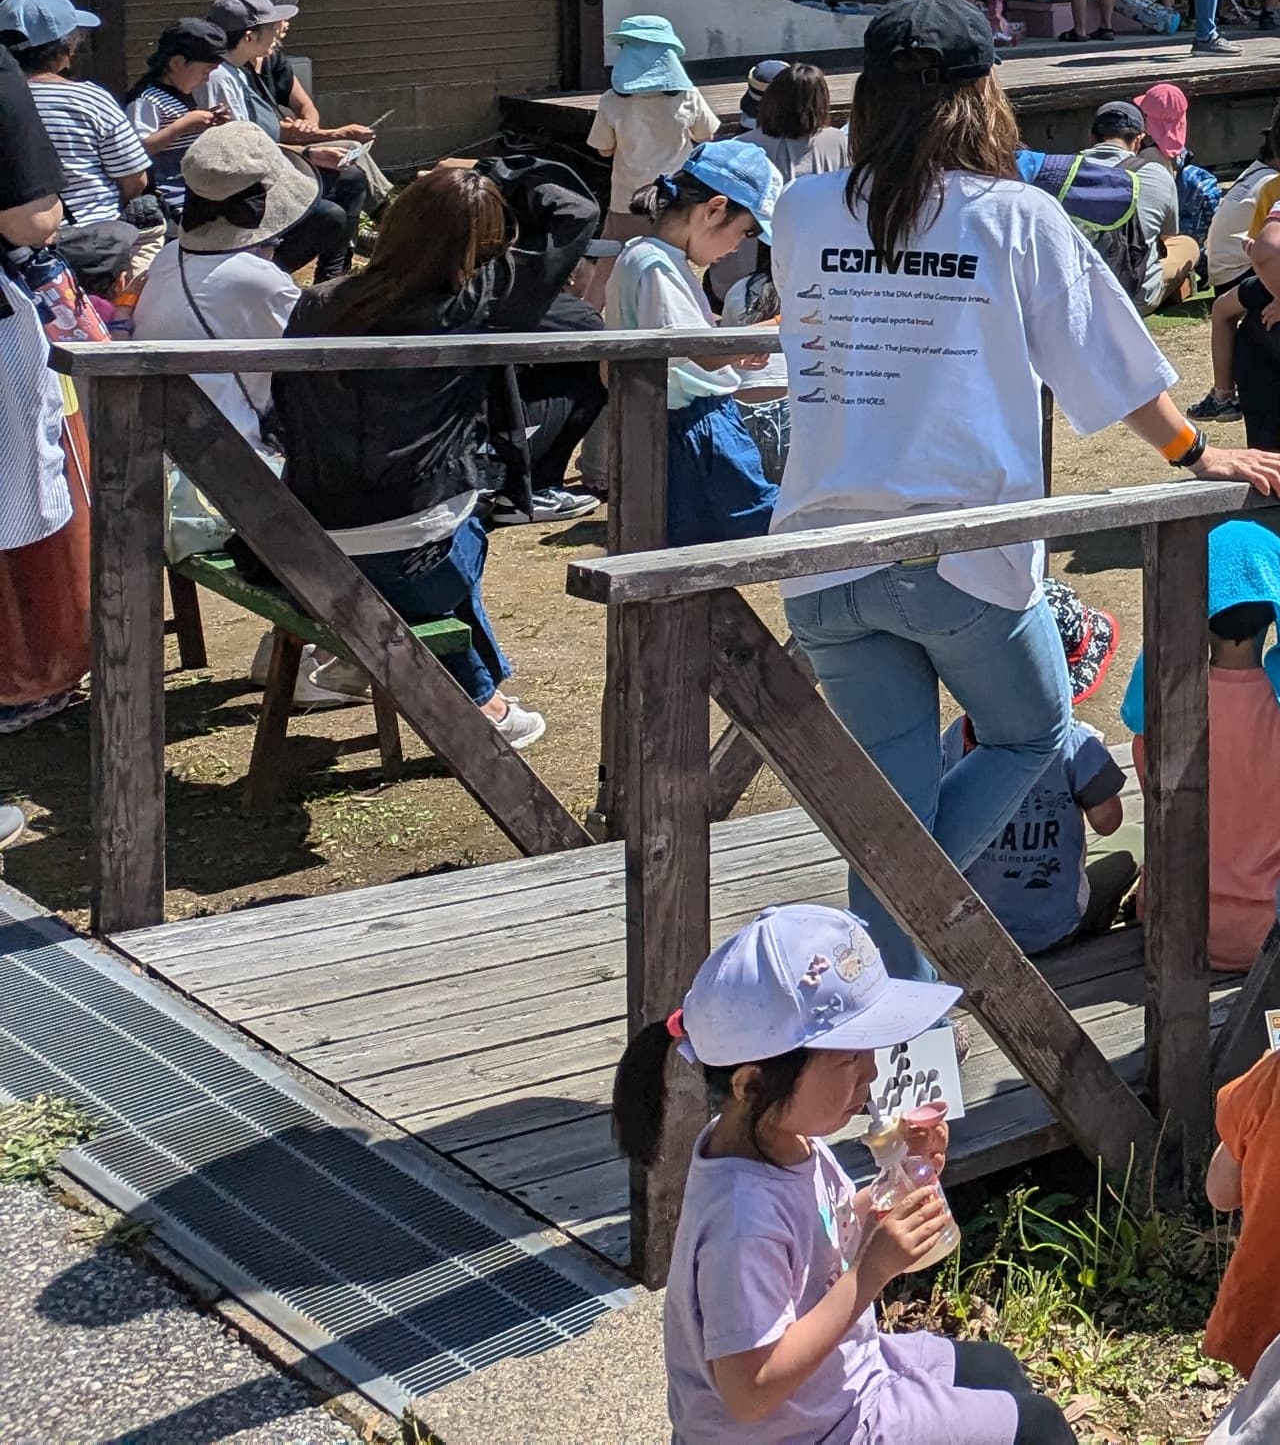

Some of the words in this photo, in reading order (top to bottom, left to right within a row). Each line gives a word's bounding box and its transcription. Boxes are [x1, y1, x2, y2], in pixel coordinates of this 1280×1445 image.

[821, 248, 979, 280] CONVERSE
[849, 289, 872, 298] Taylor
[897, 290, 912, 298] DNA
[987, 820, 1059, 851] AUR
